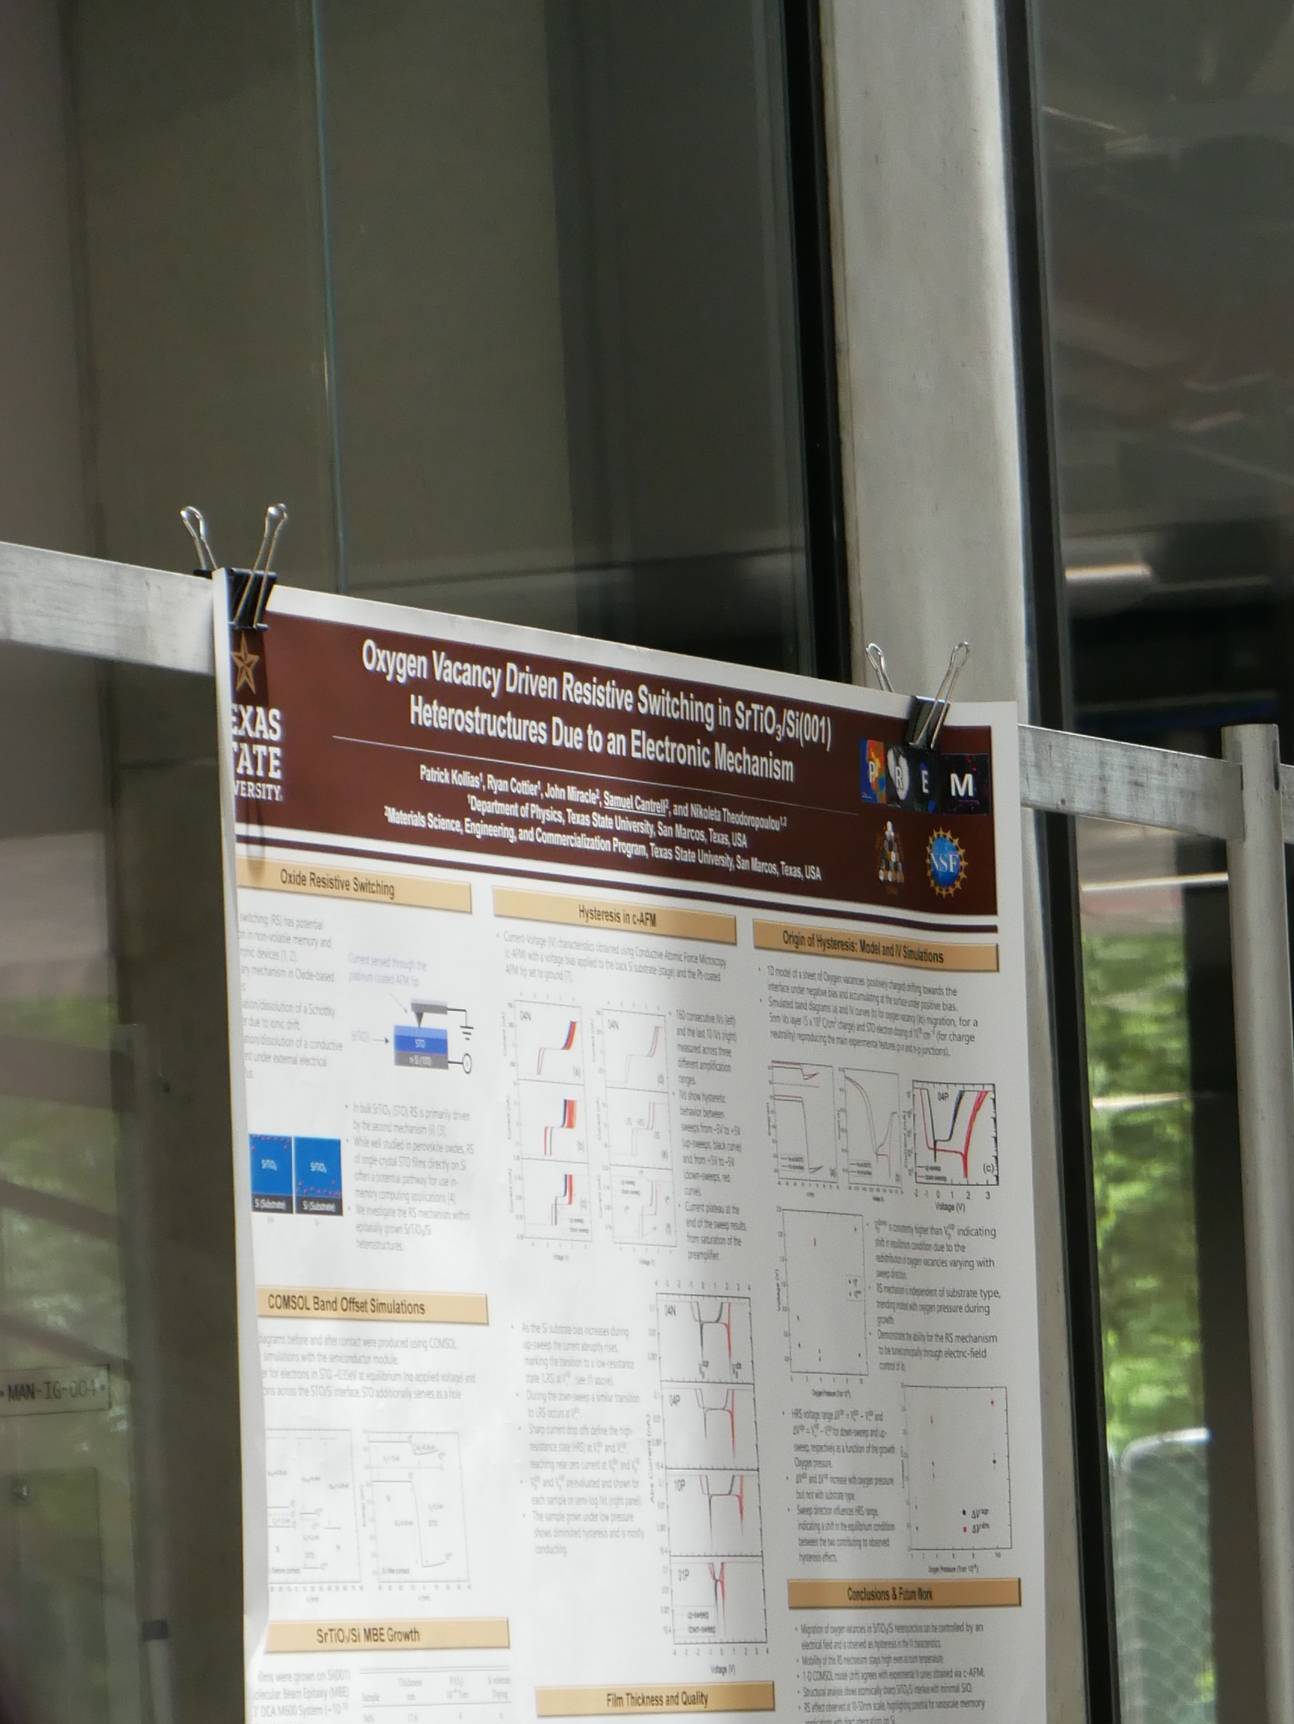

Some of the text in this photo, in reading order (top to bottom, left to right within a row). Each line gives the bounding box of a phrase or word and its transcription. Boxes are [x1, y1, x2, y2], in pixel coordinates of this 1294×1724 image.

[361, 639, 428, 683] Oxygen
[432, 650, 501, 698] Vacancy
[506, 662, 558, 700] Driven
[561, 671, 635, 713] Resistive
[637, 684, 716, 732] Switching
[719, 697, 732, 728] in
[410, 693, 795, 783] Heterostructures Due to an Electronic Mechanism
[420, 763, 450, 785] Patrick
[487, 773, 509, 795] Ryan
[545, 782, 567, 801] John
[604, 790, 634, 811] Samuel
[673, 802, 689, 817] and
[690, 803, 721, 822] Nikoleta
[520, 802, 531, 818] of
[531, 803, 564, 826] Physics,
[565, 808, 591, 826] Texas
[592, 811, 614, 830] State
[614, 815, 657, 839] University,
[658, 820, 674, 838] San
[675, 823, 707, 844] Marcos,
[708, 827, 732, 848] Texas,
[732, 831, 748, 848] USA
[427, 812, 464, 835] Science,
[464, 817, 518, 844] Engineering,
[518, 825, 535, 842] and
[535, 826, 612, 854] Commercialization
[612, 836, 649, 859] Program,
[649, 842, 673, 860] Texas
[674, 845, 697, 864] State
[697, 848, 736, 872] University,
[735, 854, 750, 871] San
[750, 857, 779, 878] Marcos,
[780, 860, 804, 881] Texas,
[804, 864, 822, 881] USA
[280, 868, 396, 901] Oxide Resistive Switching
[578, 903, 657, 928] Hysteresis in c-AFM
[782, 930, 806, 949] Origin
[807, 933, 816, 947] of
[816, 934, 858, 953] Hysteresis:
[859, 939, 881, 956] Model
[882, 943, 895, 957] and
[903, 944, 945, 964] Simulations
[959, 1014, 971, 1028] for
[948, 1028, 976, 1046] charge
[983, 1162, 995, 1175] (c)
[985, 1191, 991, 1201] 3
[957, 1224, 998, 1241] indicating
[949, 1257, 976, 1272] varying
[976, 1255, 997, 1269] with
[945, 1286, 978, 1301] substrate
[267, 1293, 427, 1315] COMSOL Band Offset Simulations
[964, 1301, 990, 1318] during
[954, 1331, 998, 1345] mechanism
[943, 1345, 988, 1360] electric-field
[847, 1589, 890, 1603] Conclusions
[363, 1629, 386, 1643] MBE
[387, 1628, 420, 1643] Growth
[606, 1692, 709, 1707] Film Thickness and Quality
